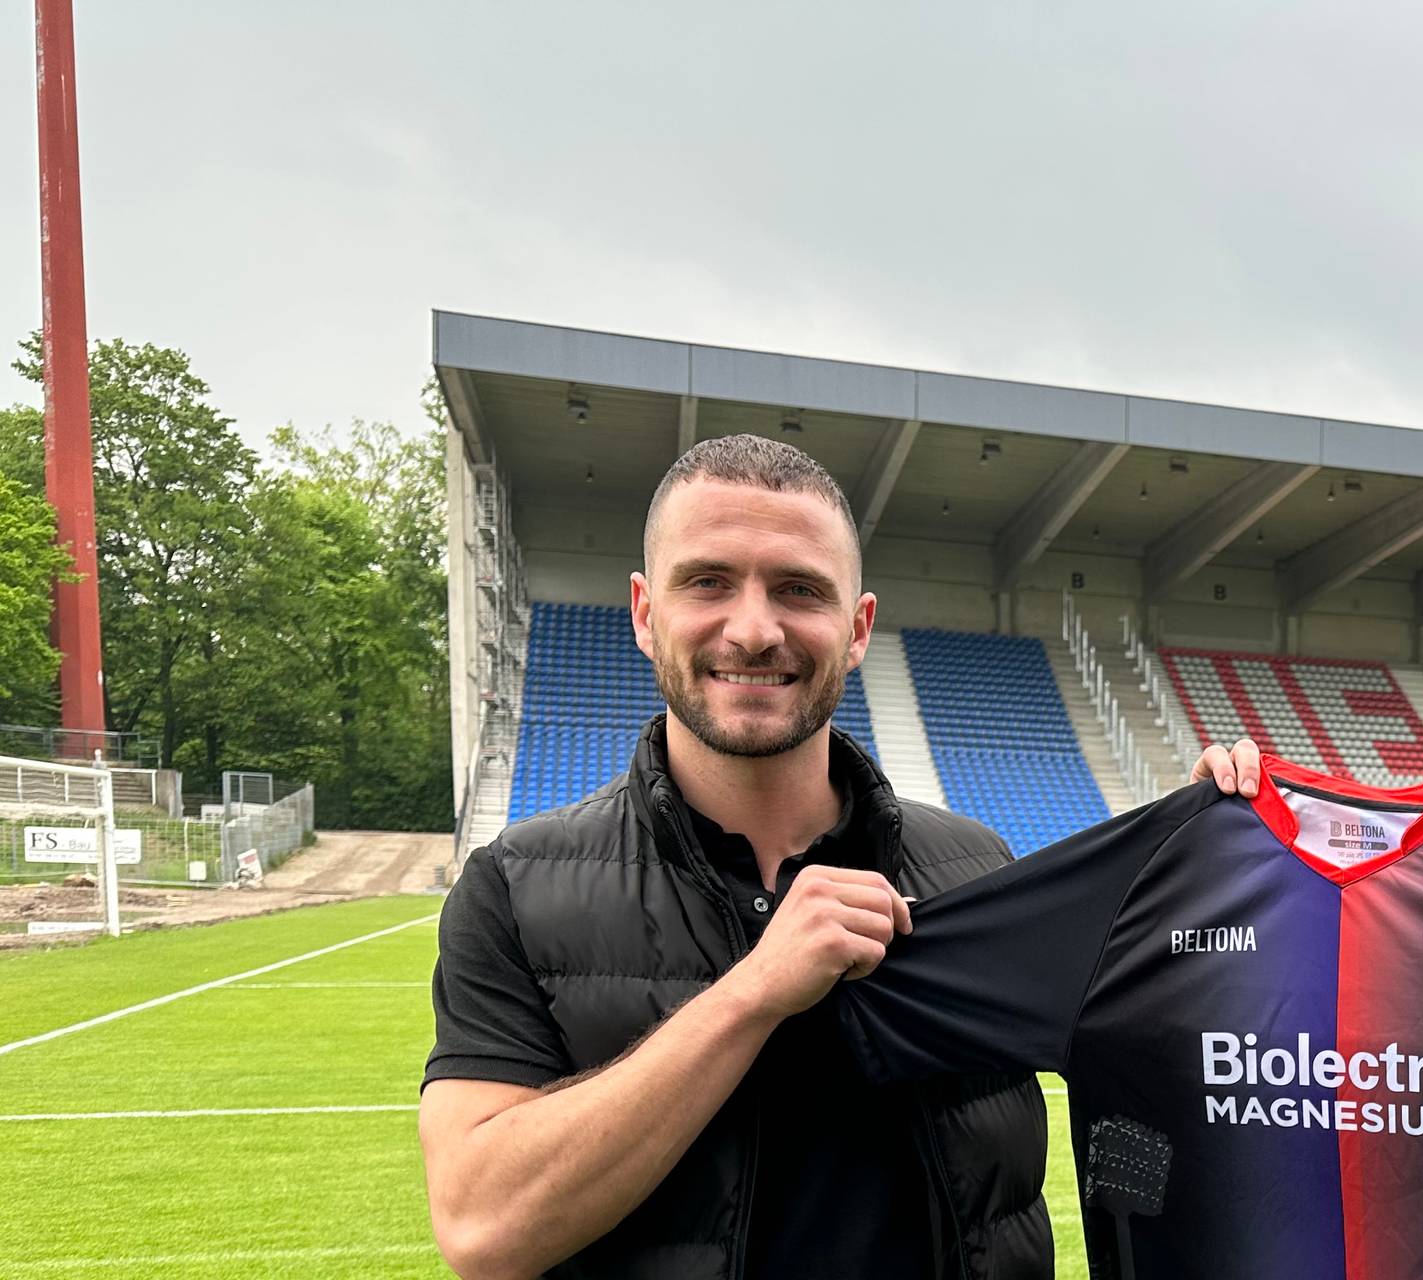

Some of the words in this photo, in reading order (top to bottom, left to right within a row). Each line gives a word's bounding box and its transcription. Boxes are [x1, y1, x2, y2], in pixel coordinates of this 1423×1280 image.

[1071, 572, 1085, 589] B
[1213, 584, 1227, 601] B
[1345, 823, 1386, 838] BELTONA
[31, 832, 58, 850] FS
[1344, 840, 1361, 850] size
[1171, 925, 1257, 954] BELTONA
